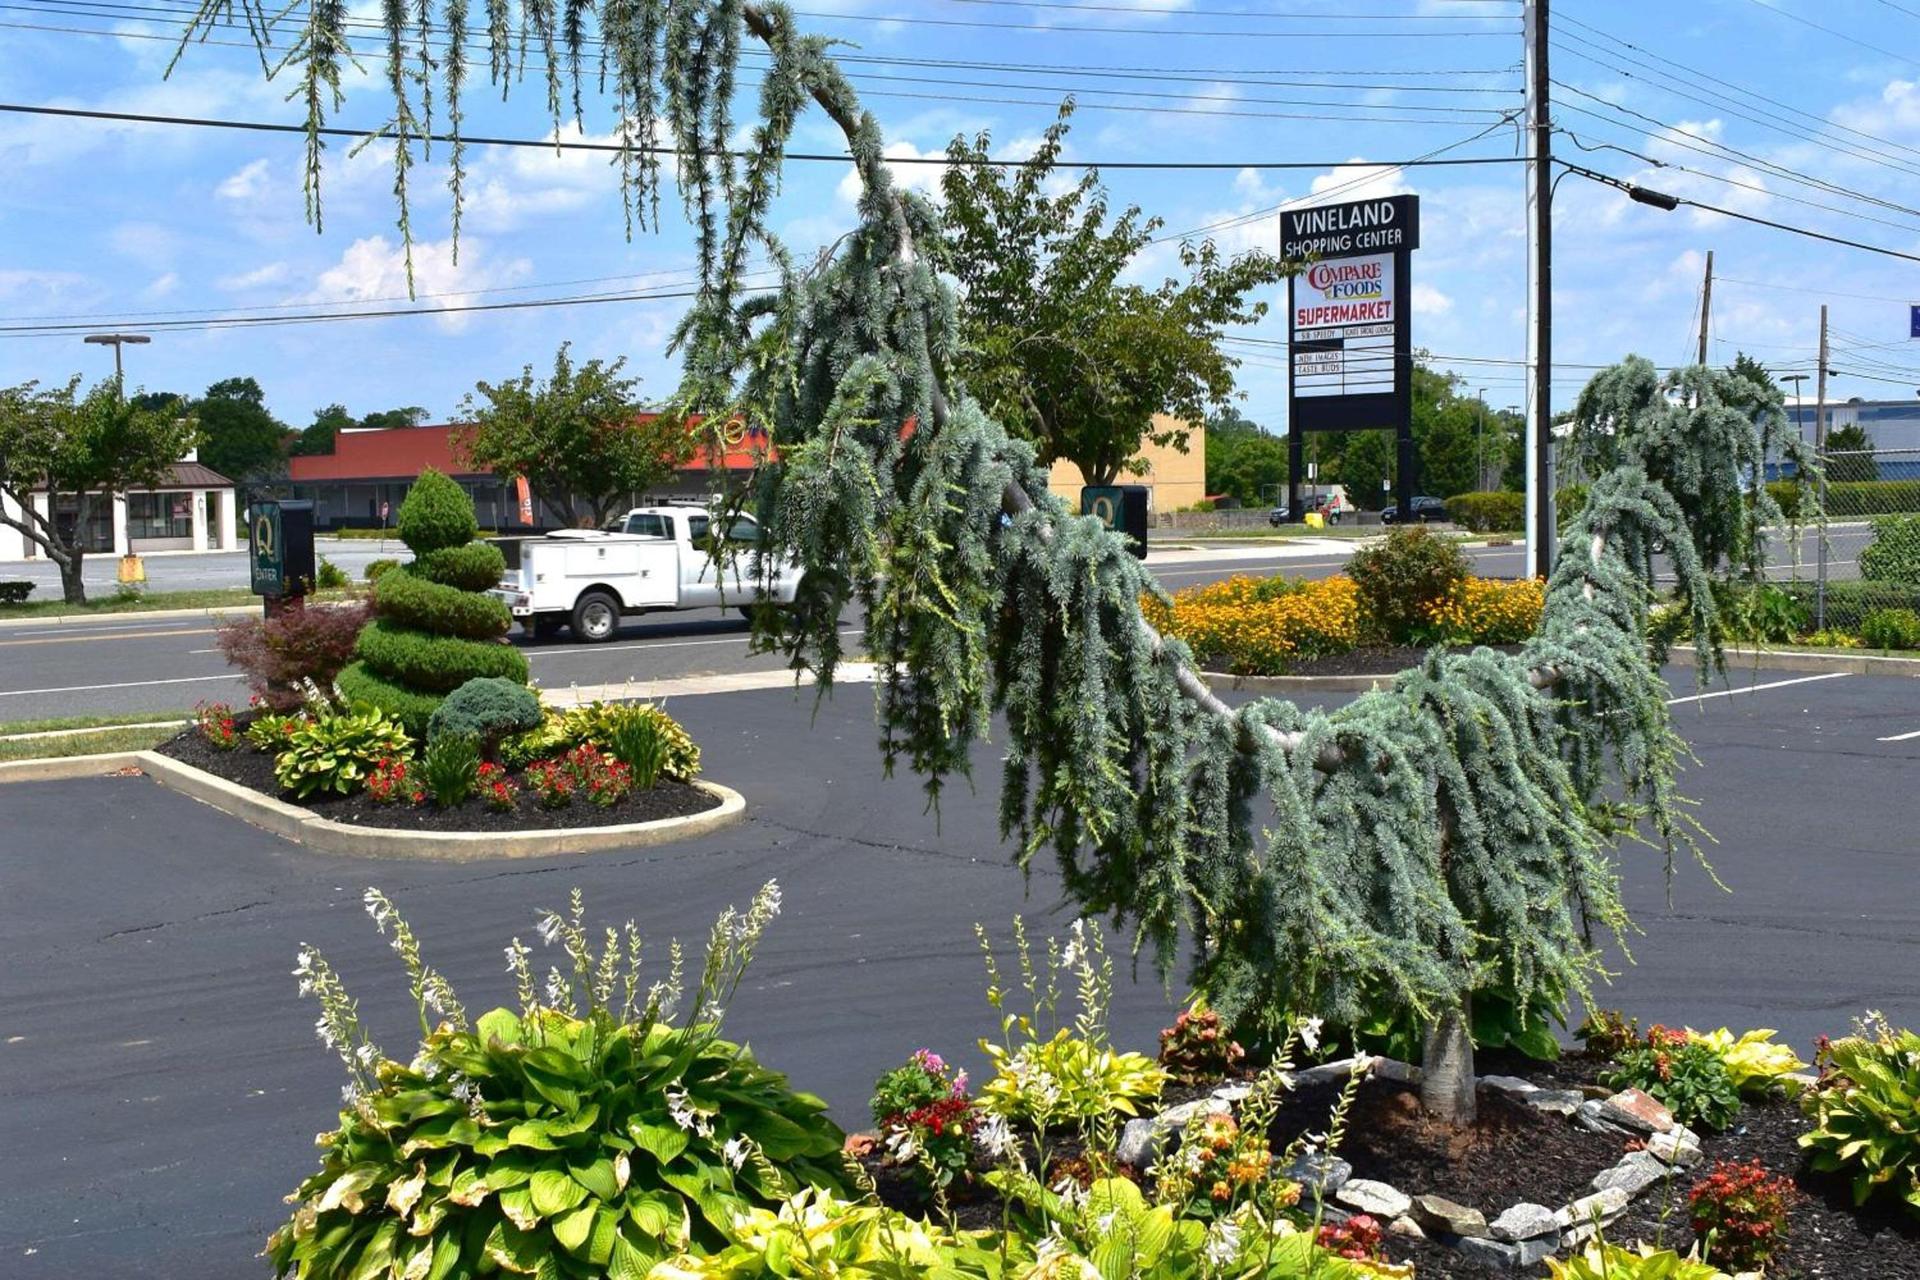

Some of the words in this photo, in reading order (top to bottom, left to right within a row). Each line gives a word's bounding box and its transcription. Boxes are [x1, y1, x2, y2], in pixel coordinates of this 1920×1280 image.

[1293, 201, 1395, 235] VINELAND
[1285, 234, 1352, 257] SHOPPING
[1356, 228, 1402, 248] CENTER
[1333, 279, 1382, 298] FOODS
[1298, 301, 1391, 326] SUPERMARKET
[1315, 353, 1338, 362] IMAGES
[256, 516, 273, 556] Q
[255, 568, 277, 581] ENTER
